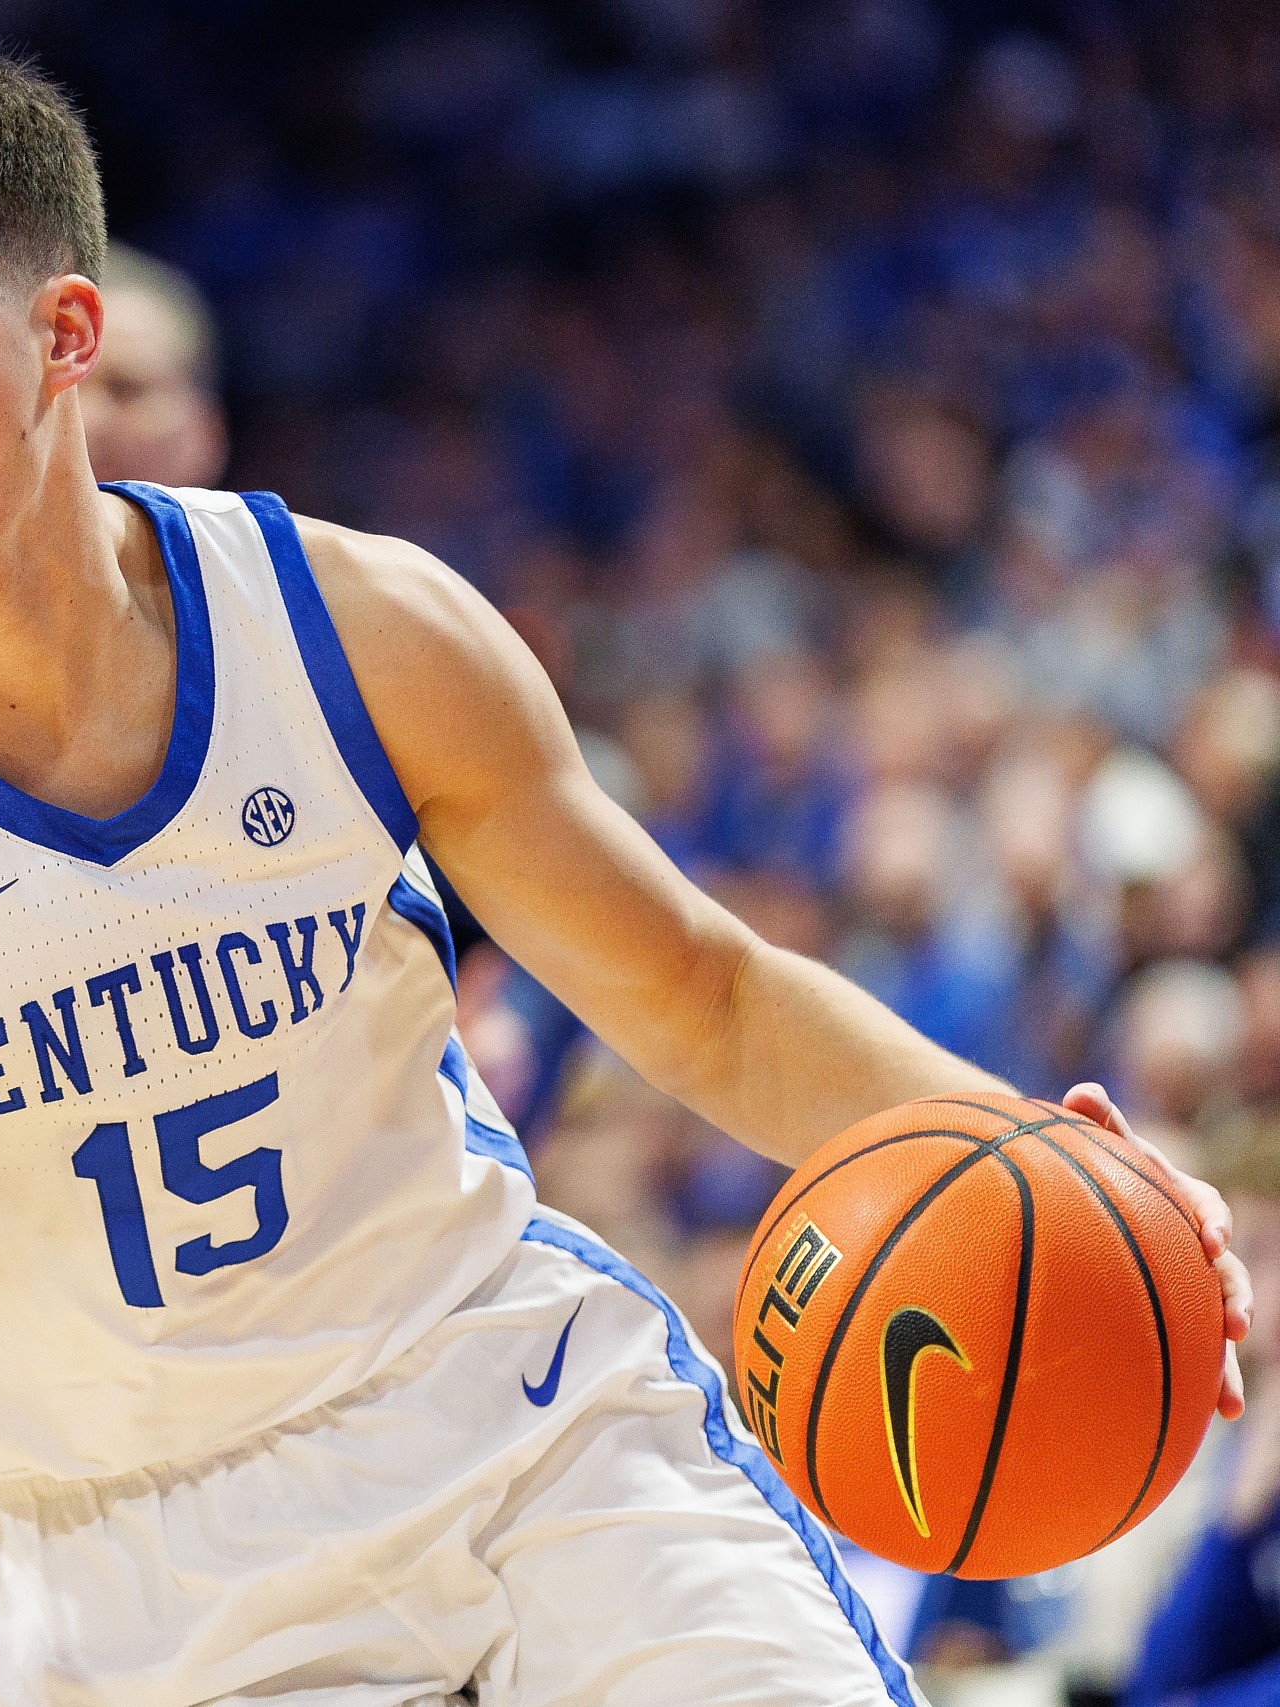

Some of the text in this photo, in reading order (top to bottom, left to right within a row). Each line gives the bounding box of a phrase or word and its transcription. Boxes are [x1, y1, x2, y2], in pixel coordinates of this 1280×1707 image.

[244, 789, 294, 845] SEC
[71, 1071, 289, 1308] 15
[747, 1220, 844, 1467] ELITE
